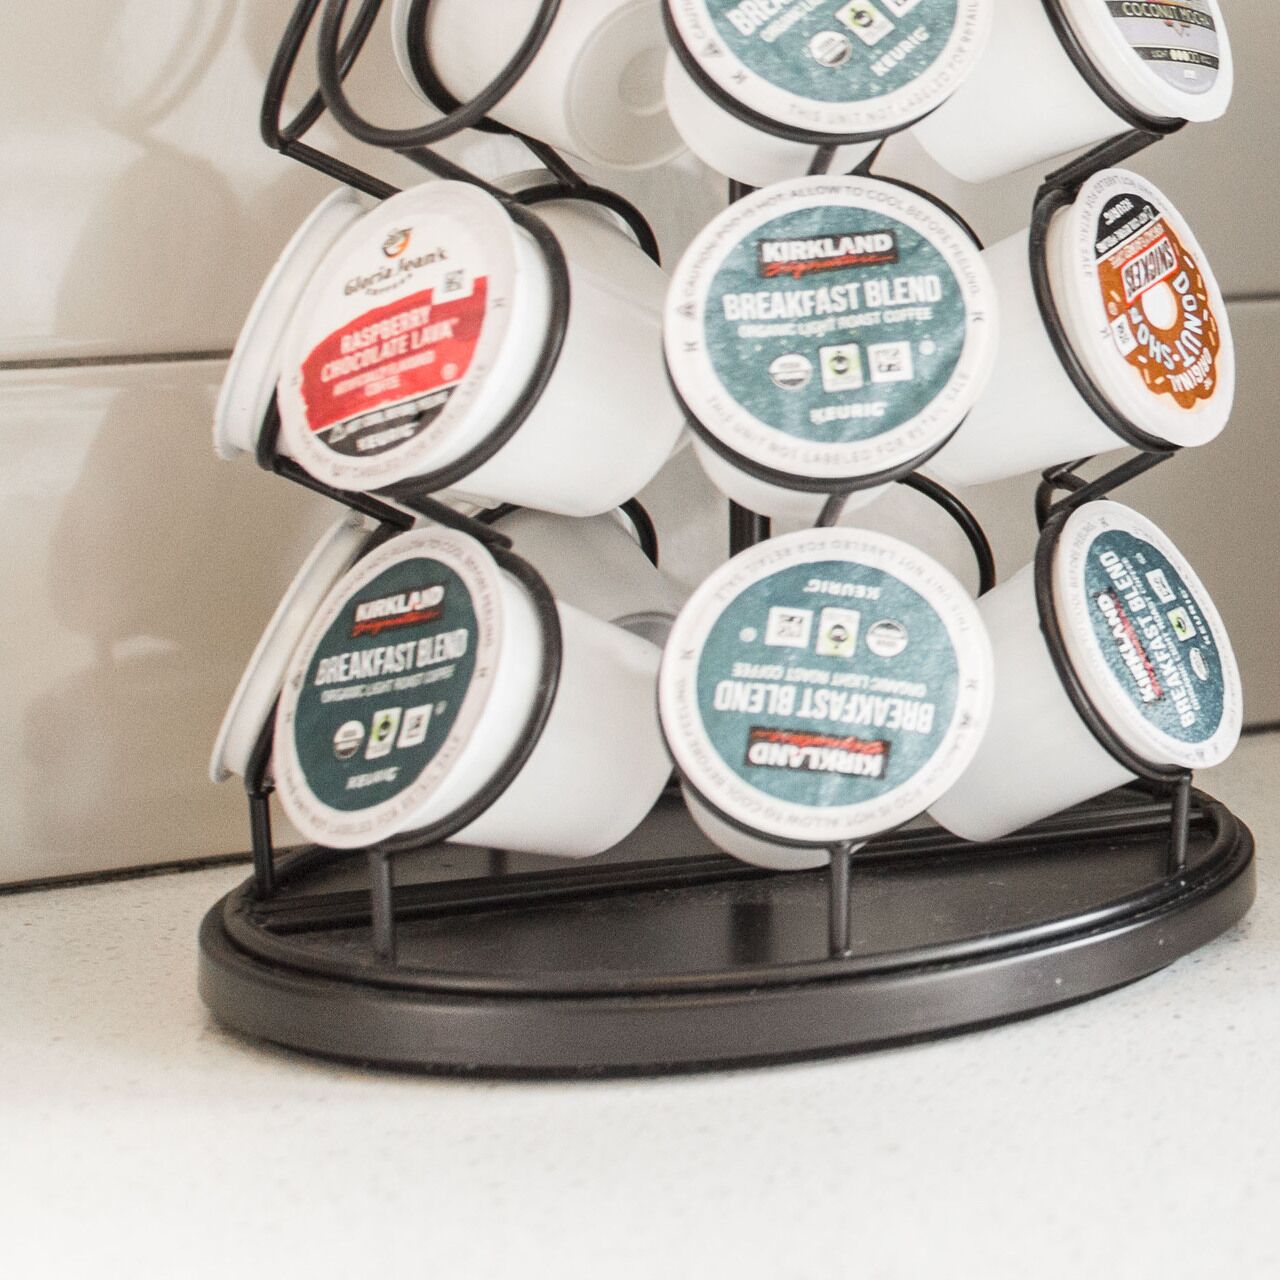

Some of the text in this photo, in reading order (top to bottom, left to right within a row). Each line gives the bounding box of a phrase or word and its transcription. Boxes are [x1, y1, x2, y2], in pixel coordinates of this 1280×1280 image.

[1121, 1, 1179, 20] COCONUT
[869, 24, 931, 78] KEURIG
[762, 233, 893, 263] KIRKLAND
[343, 268, 394, 297] Gloria
[722, 275, 942, 322] BREAKFAST BLEND
[340, 306, 432, 355] RASPBERRY
[883, 307, 935, 325] COFFEE
[1170, 270, 1203, 368] DONUT
[320, 334, 410, 383] CHOCOLATE
[1167, 347, 1212, 393] ORIGINAL
[809, 402, 888, 425] KEURIG
[355, 585, 446, 623] KIRKLAND
[802, 577, 881, 601] KEURIG
[315, 628, 469, 686] BREAKFAST BLEND
[1097, 593, 1155, 703] KIRKLAND
[1100, 550, 1196, 729] BREAKFAST BLEND
[730, 662, 783, 680] COFFEE
[713, 679, 936, 734] BREAKFAST BLEND
[748, 742, 884, 777] KIRKLAND
